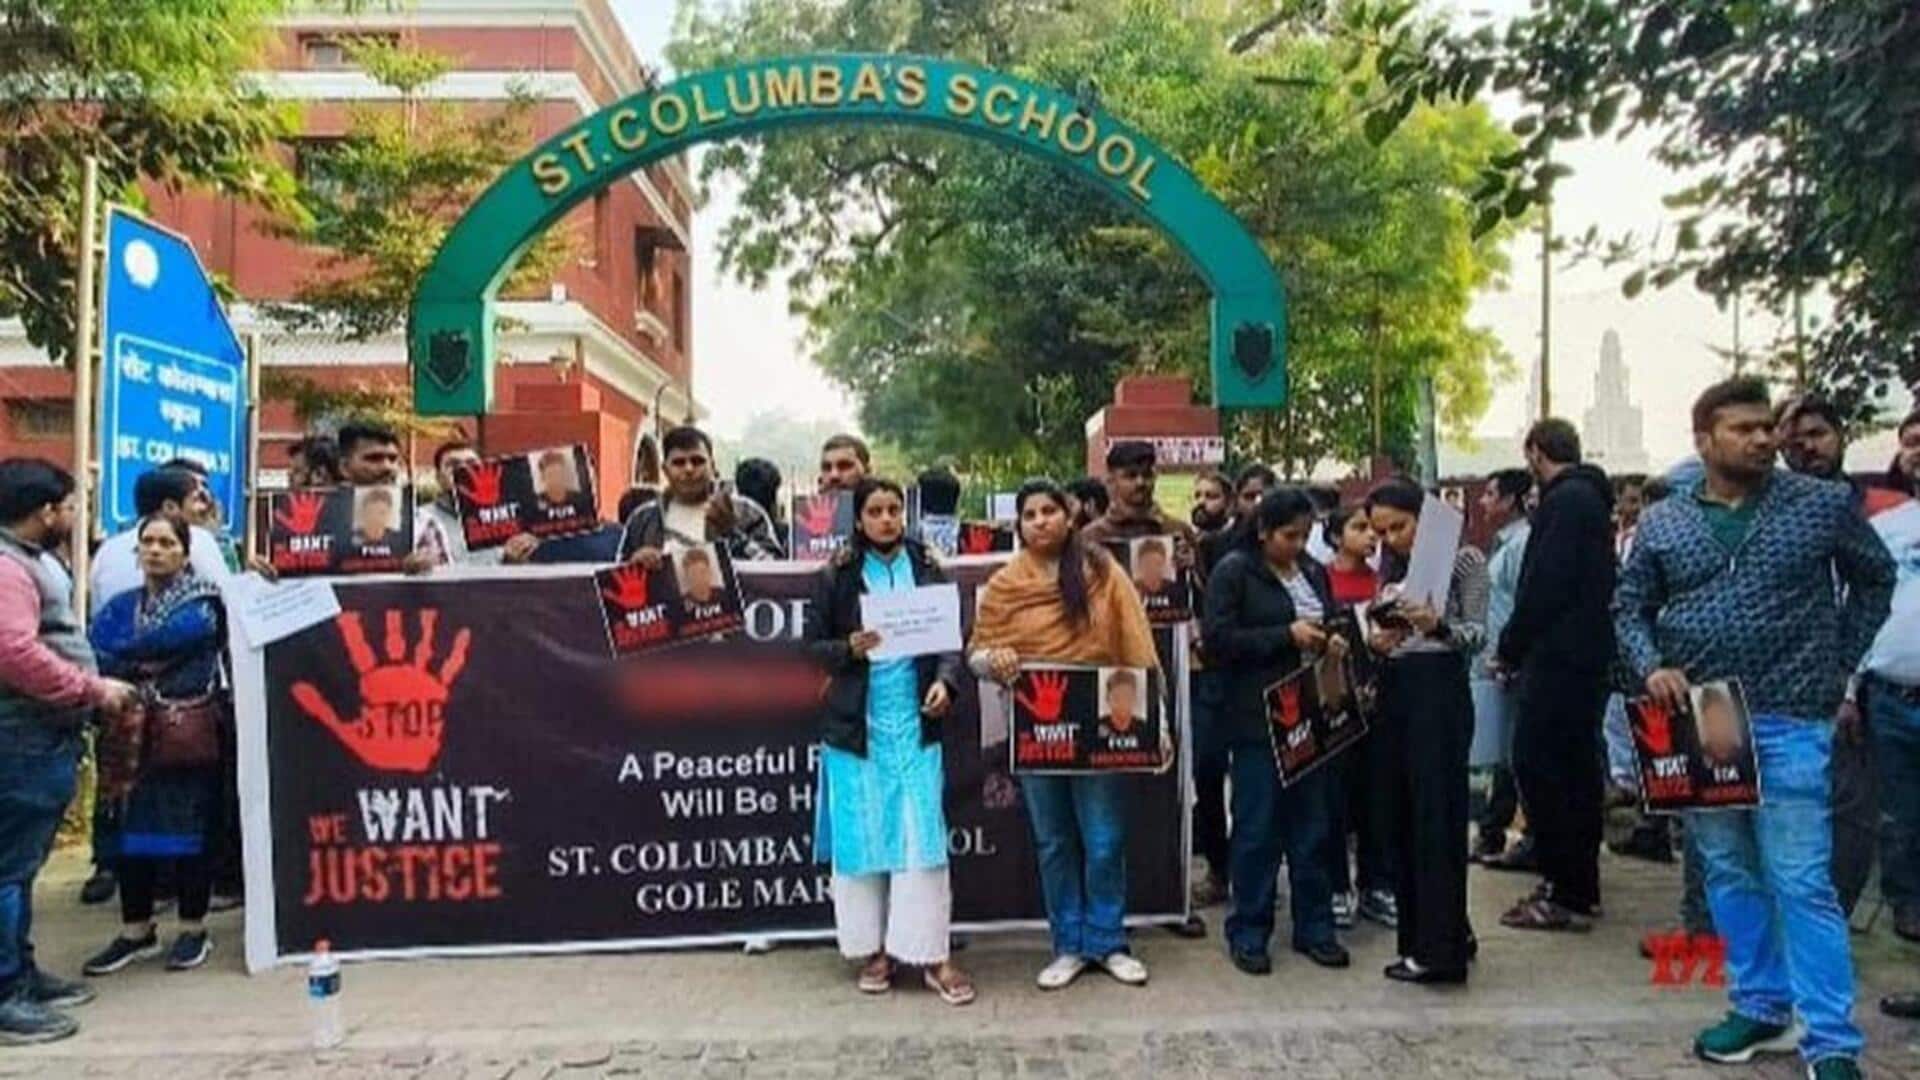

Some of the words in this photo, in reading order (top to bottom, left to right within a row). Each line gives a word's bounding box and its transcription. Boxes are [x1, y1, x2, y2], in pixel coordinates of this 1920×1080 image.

[946, 73, 1156, 201] SCHOOL
[357, 698, 444, 740] STOP
[618, 753, 643, 782] A
[654, 746, 795, 780] Peaceful
[309, 814, 348, 844] WE
[357, 784, 511, 843] WANT
[661, 787, 724, 819] Will
[735, 786, 778, 816] Be
[303, 843, 503, 906] JUSTICE
[549, 846, 601, 877] ST.
[609, 834, 812, 874] COLUMBA'
[636, 879, 744, 914] GOLE
[752, 874, 835, 908] MAR
